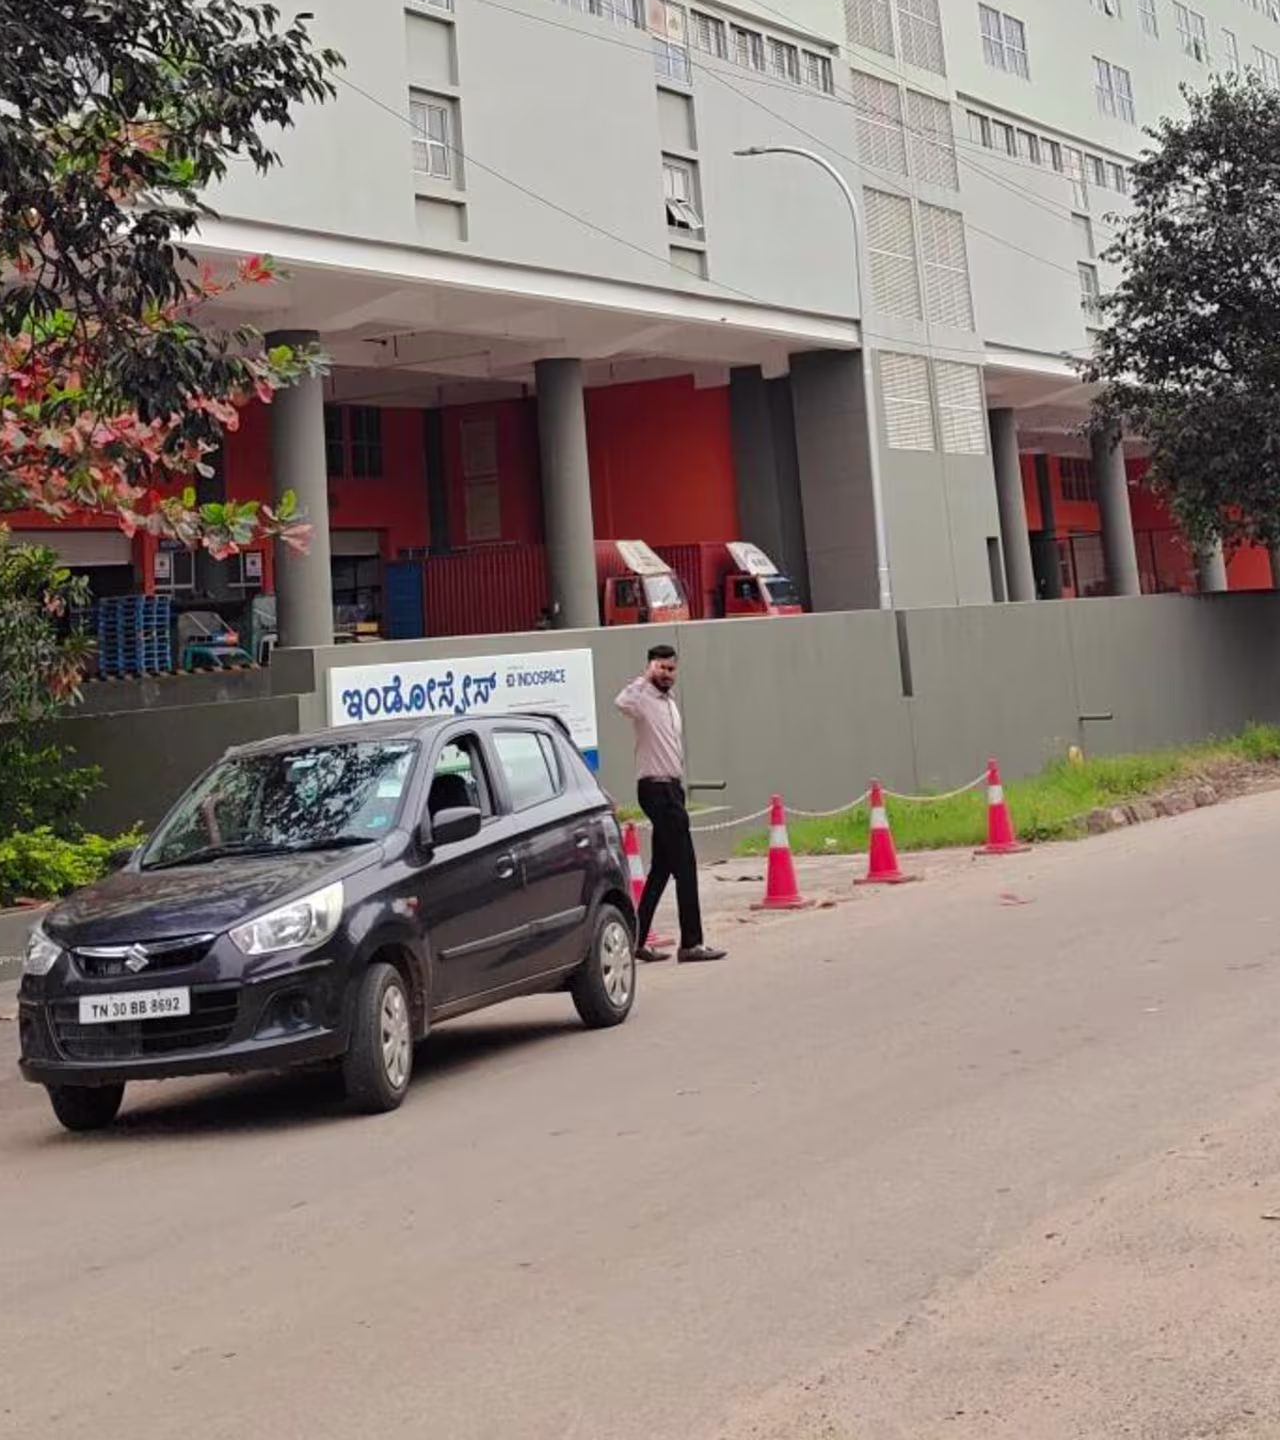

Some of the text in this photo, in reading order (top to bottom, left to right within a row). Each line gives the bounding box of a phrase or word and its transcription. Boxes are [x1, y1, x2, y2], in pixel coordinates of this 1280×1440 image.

[517, 668, 566, 688] INDOSPACE
[92, 997, 180, 1018] TN 30 BB 8692
